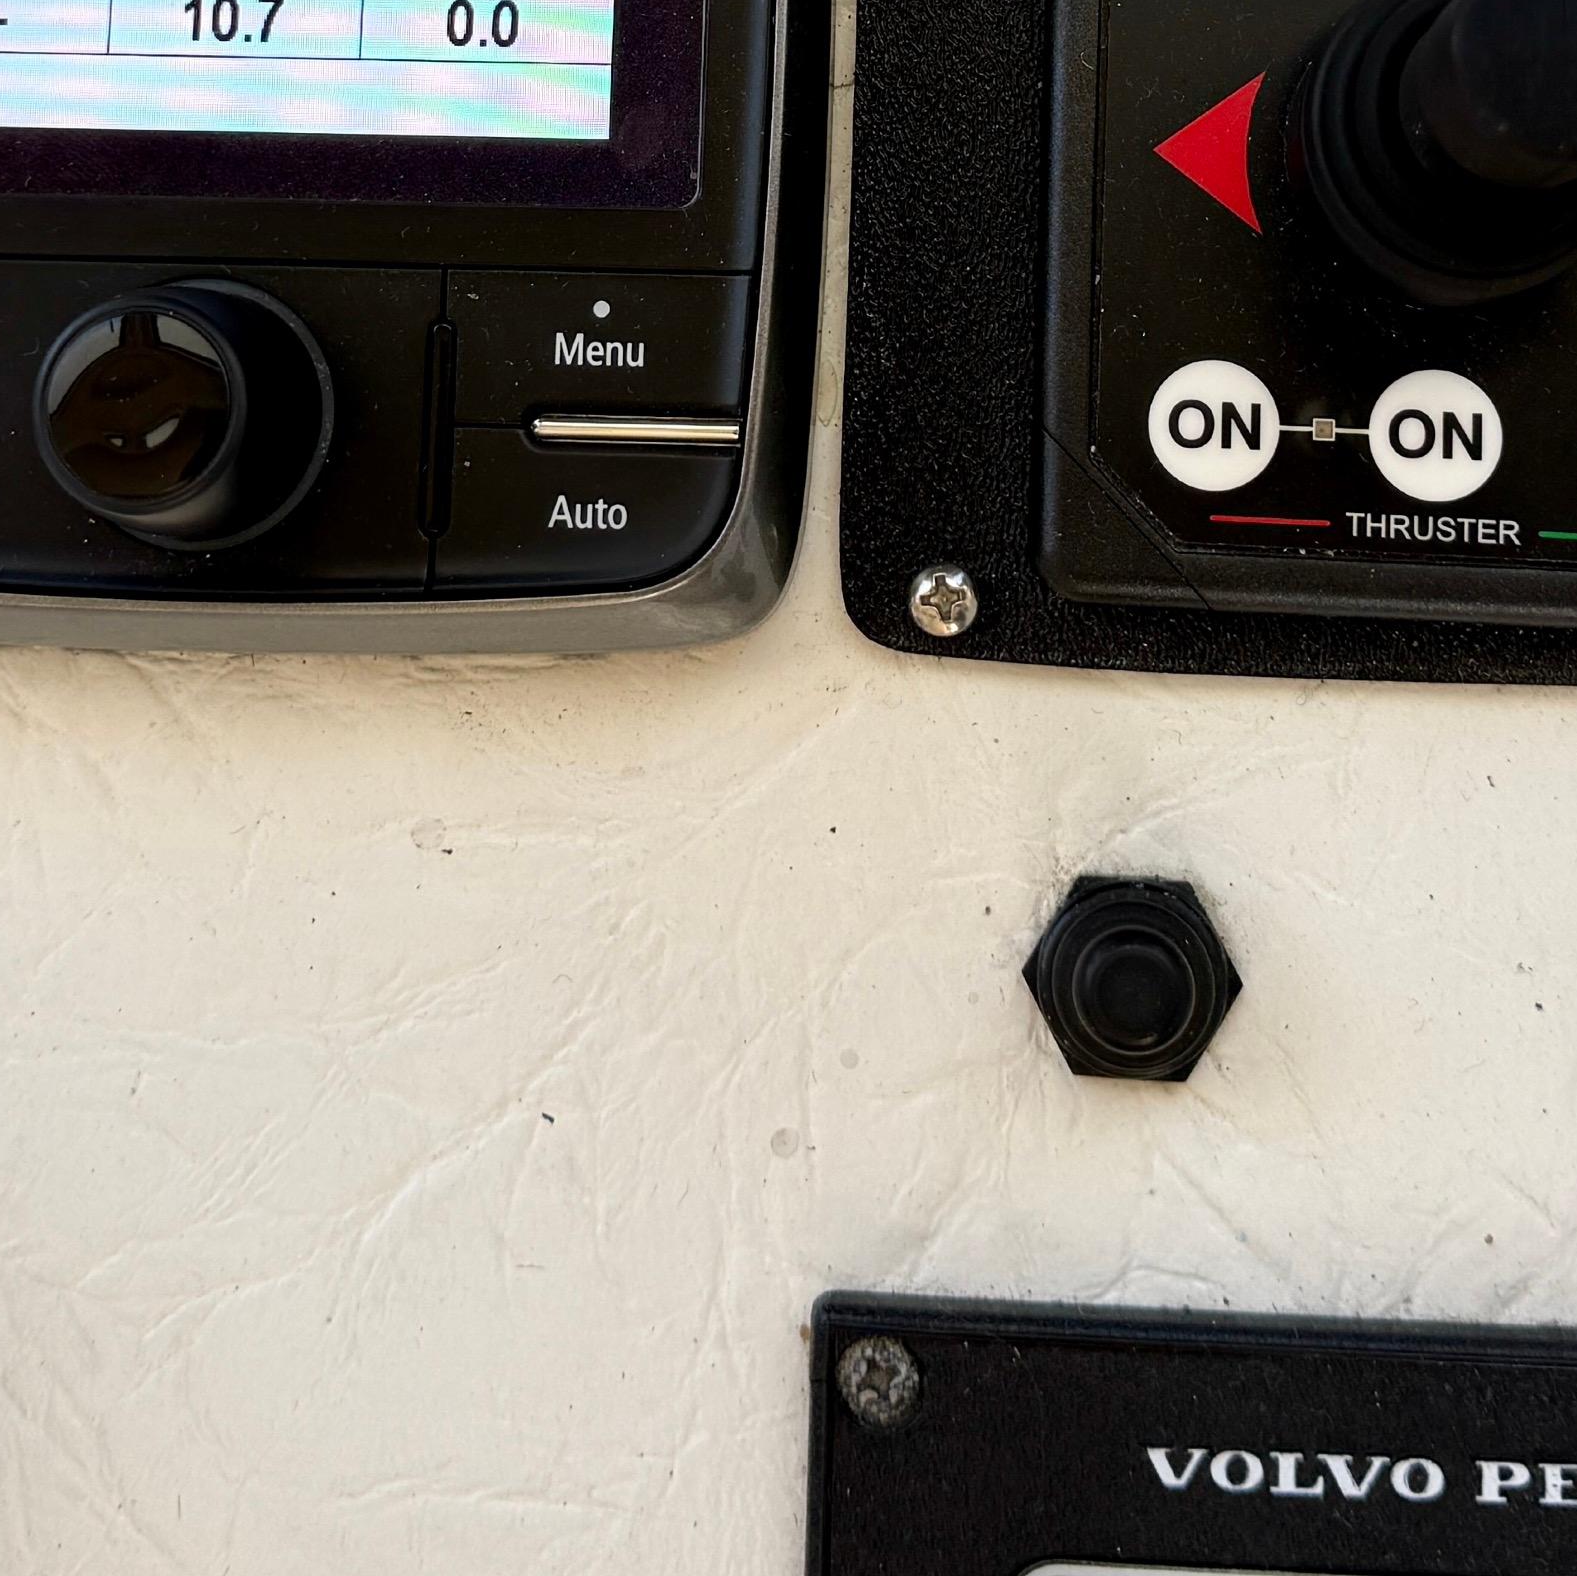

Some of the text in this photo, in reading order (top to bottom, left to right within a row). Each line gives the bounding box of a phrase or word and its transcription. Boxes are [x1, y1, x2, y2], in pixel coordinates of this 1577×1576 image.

[553, 331, 645, 370] Menu
[1167, 398, 1262, 452] ON
[1387, 410, 1484, 463] ON
[548, 494, 628, 530] Auto
[1345, 512, 1522, 547] THRUSTER
[1146, 1447, 1446, 1503] VOLVO
